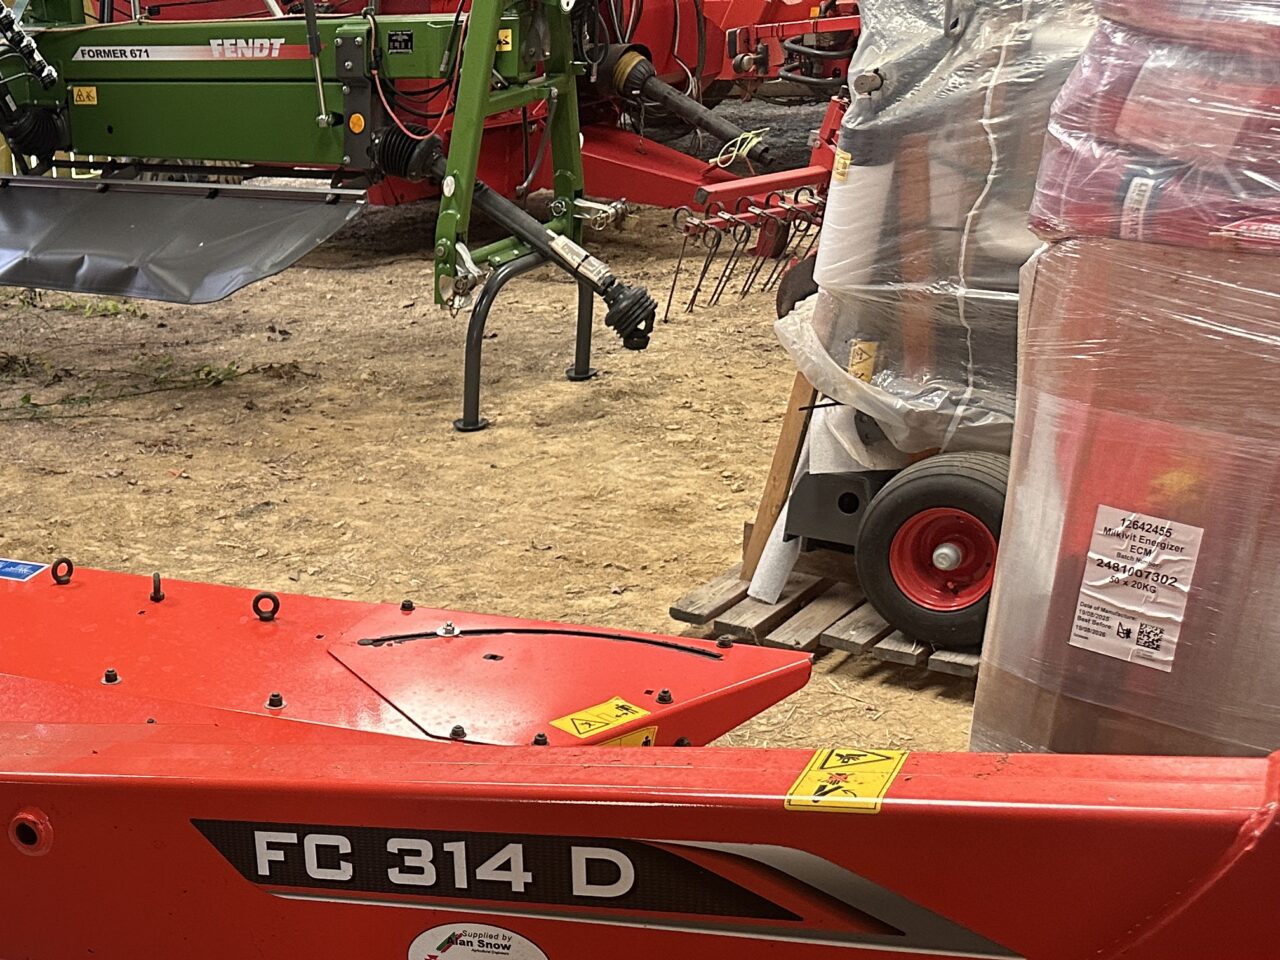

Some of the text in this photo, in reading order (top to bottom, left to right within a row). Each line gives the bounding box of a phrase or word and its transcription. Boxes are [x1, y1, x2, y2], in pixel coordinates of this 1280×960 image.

[81, 48, 150, 59] FORMER 671
[209, 38, 285, 58] FENDT
[1120, 518, 1173, 538] 12642455
[1129, 544, 1152, 557] ECM
[1138, 535, 1184, 553] Energizer
[1116, 552, 1134, 561] Batch
[1096, 558, 1178, 587] 2481007302
[1109, 575, 1120, 584] 50
[1131, 580, 1157, 594] 20KG
[253, 830, 635, 898] FC 314 D
[446, 937, 511, 951] Alan Snow
[462, 930, 513, 942] Supplied by
